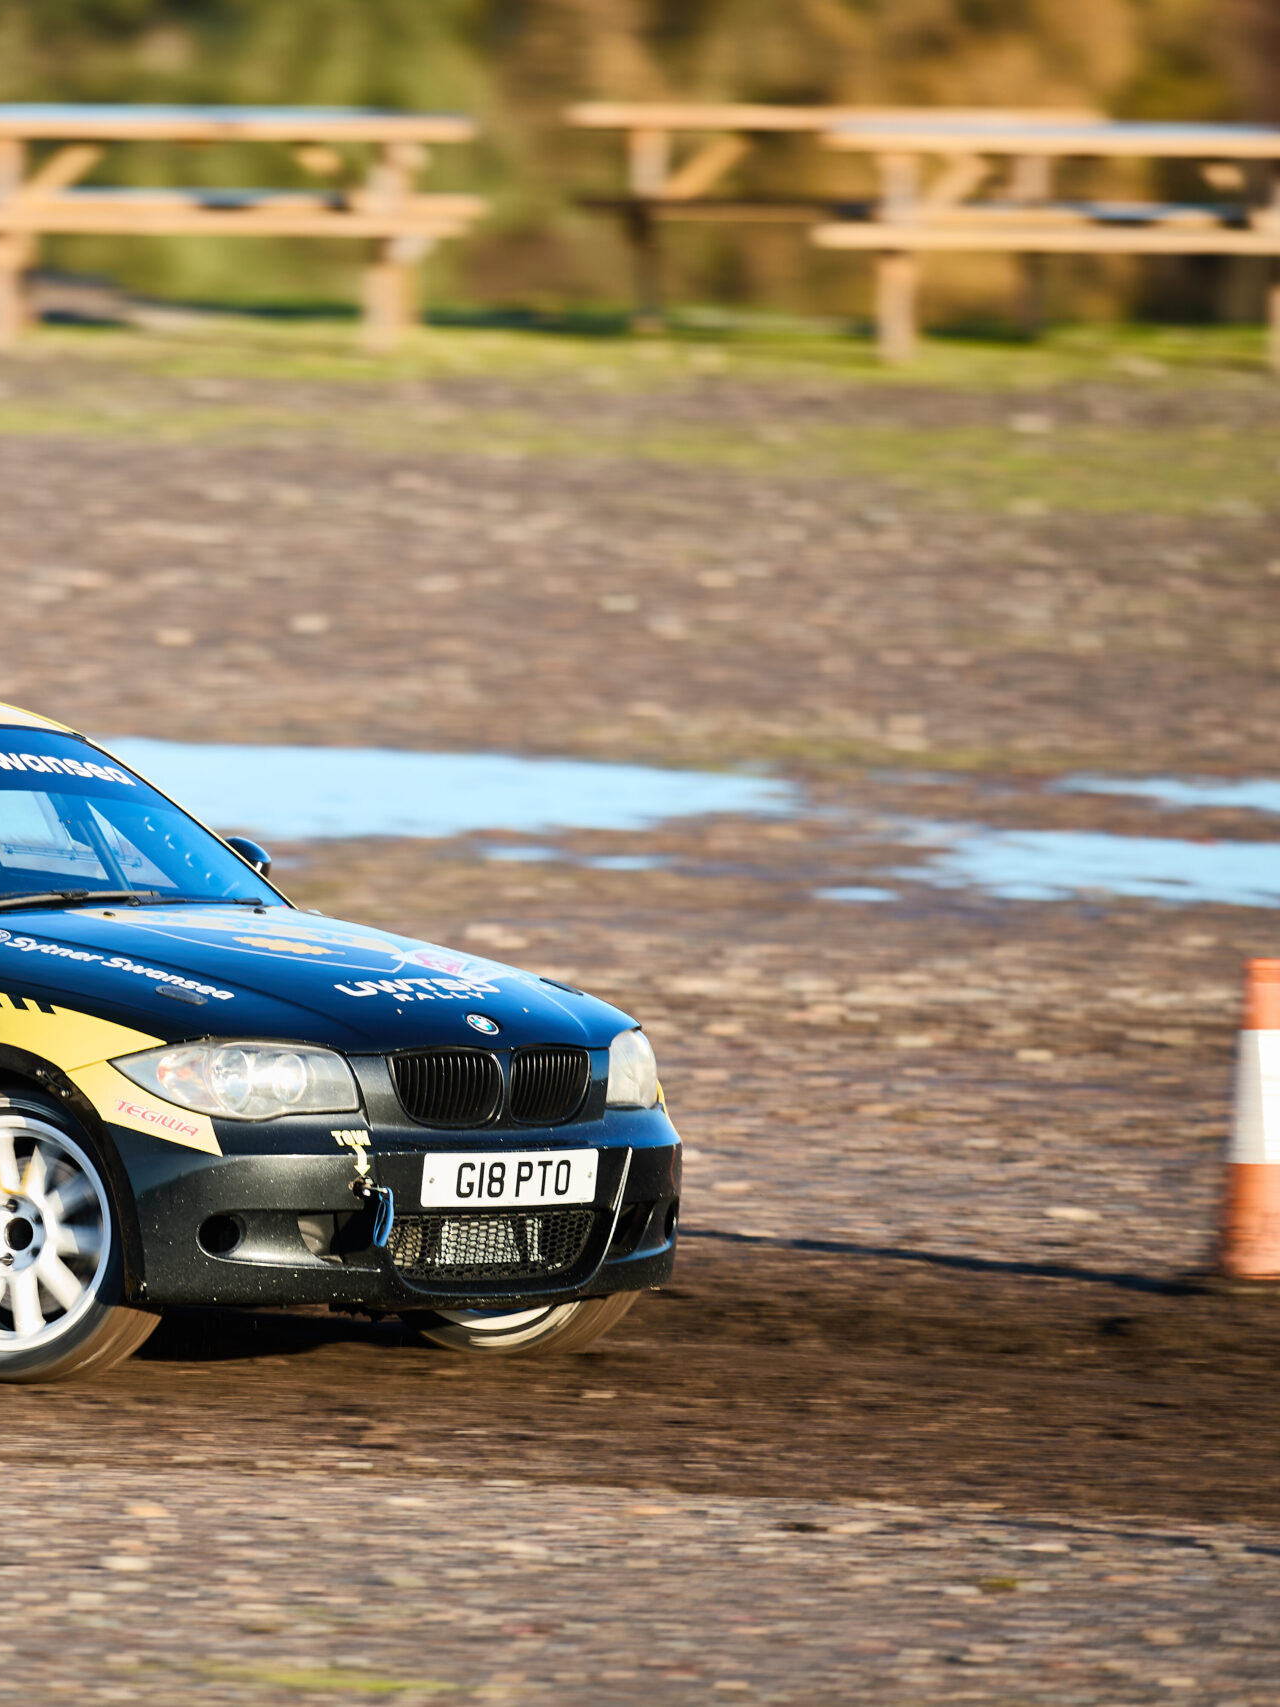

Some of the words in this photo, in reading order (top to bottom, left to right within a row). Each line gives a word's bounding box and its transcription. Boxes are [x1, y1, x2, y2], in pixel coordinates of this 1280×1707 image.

[5, 936, 104, 962] Sytner
[101, 956, 235, 1001] Swansea
[333, 977, 501, 998] UWTSD
[392, 991, 486, 1003] RALLY
[115, 1099, 200, 1138] TEGIWA
[331, 1129, 372, 1147] TOW
[456, 1161, 506, 1199] G18
[515, 1159, 572, 1198] PTO
